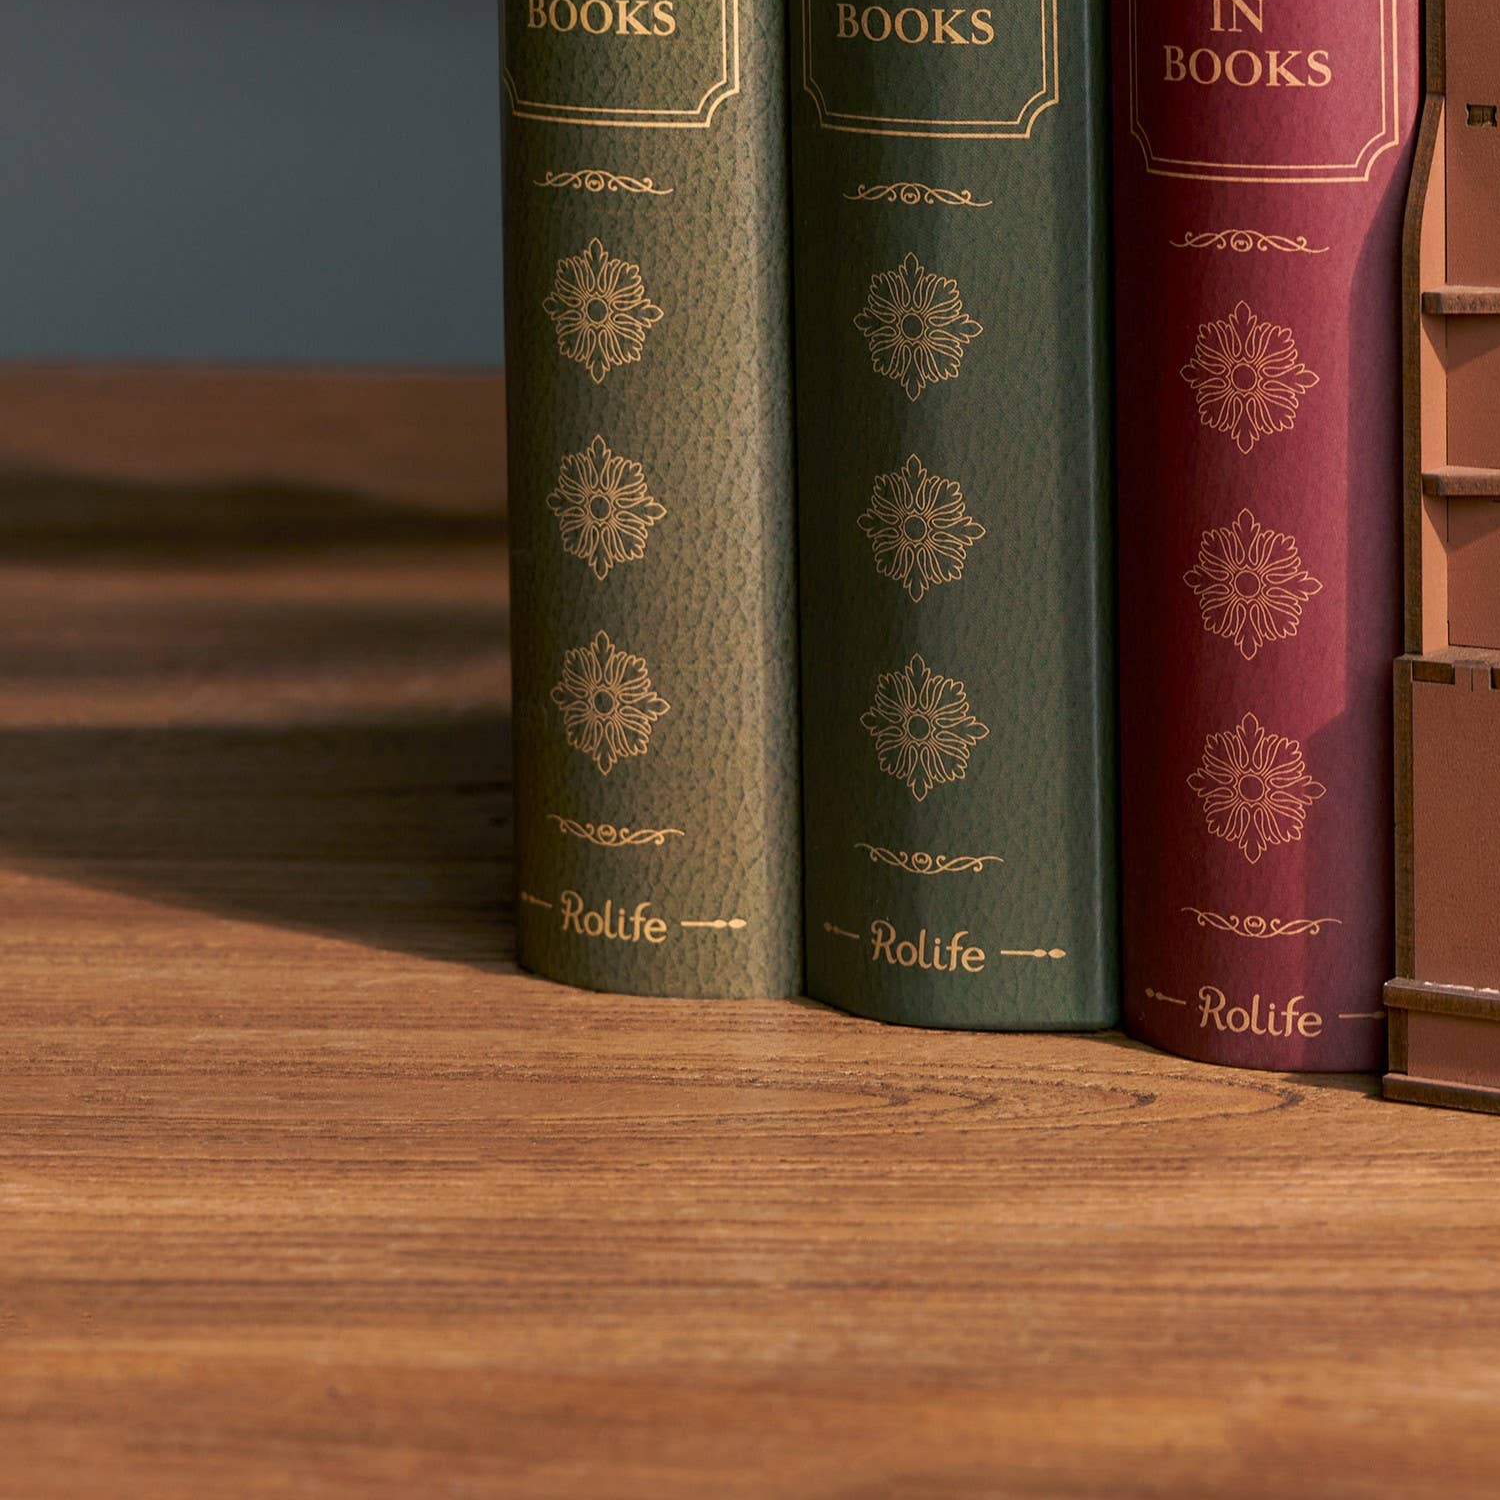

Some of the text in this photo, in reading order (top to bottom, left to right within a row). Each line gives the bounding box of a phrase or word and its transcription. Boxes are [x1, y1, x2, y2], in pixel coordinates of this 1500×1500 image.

[836, 2, 995, 46] BOOKS
[1163, 44, 1332, 88] BOOKS
[561, 890, 668, 943] Rolife
[871, 920, 986, 973] Rolife
[1198, 986, 1323, 1038] Rolife
